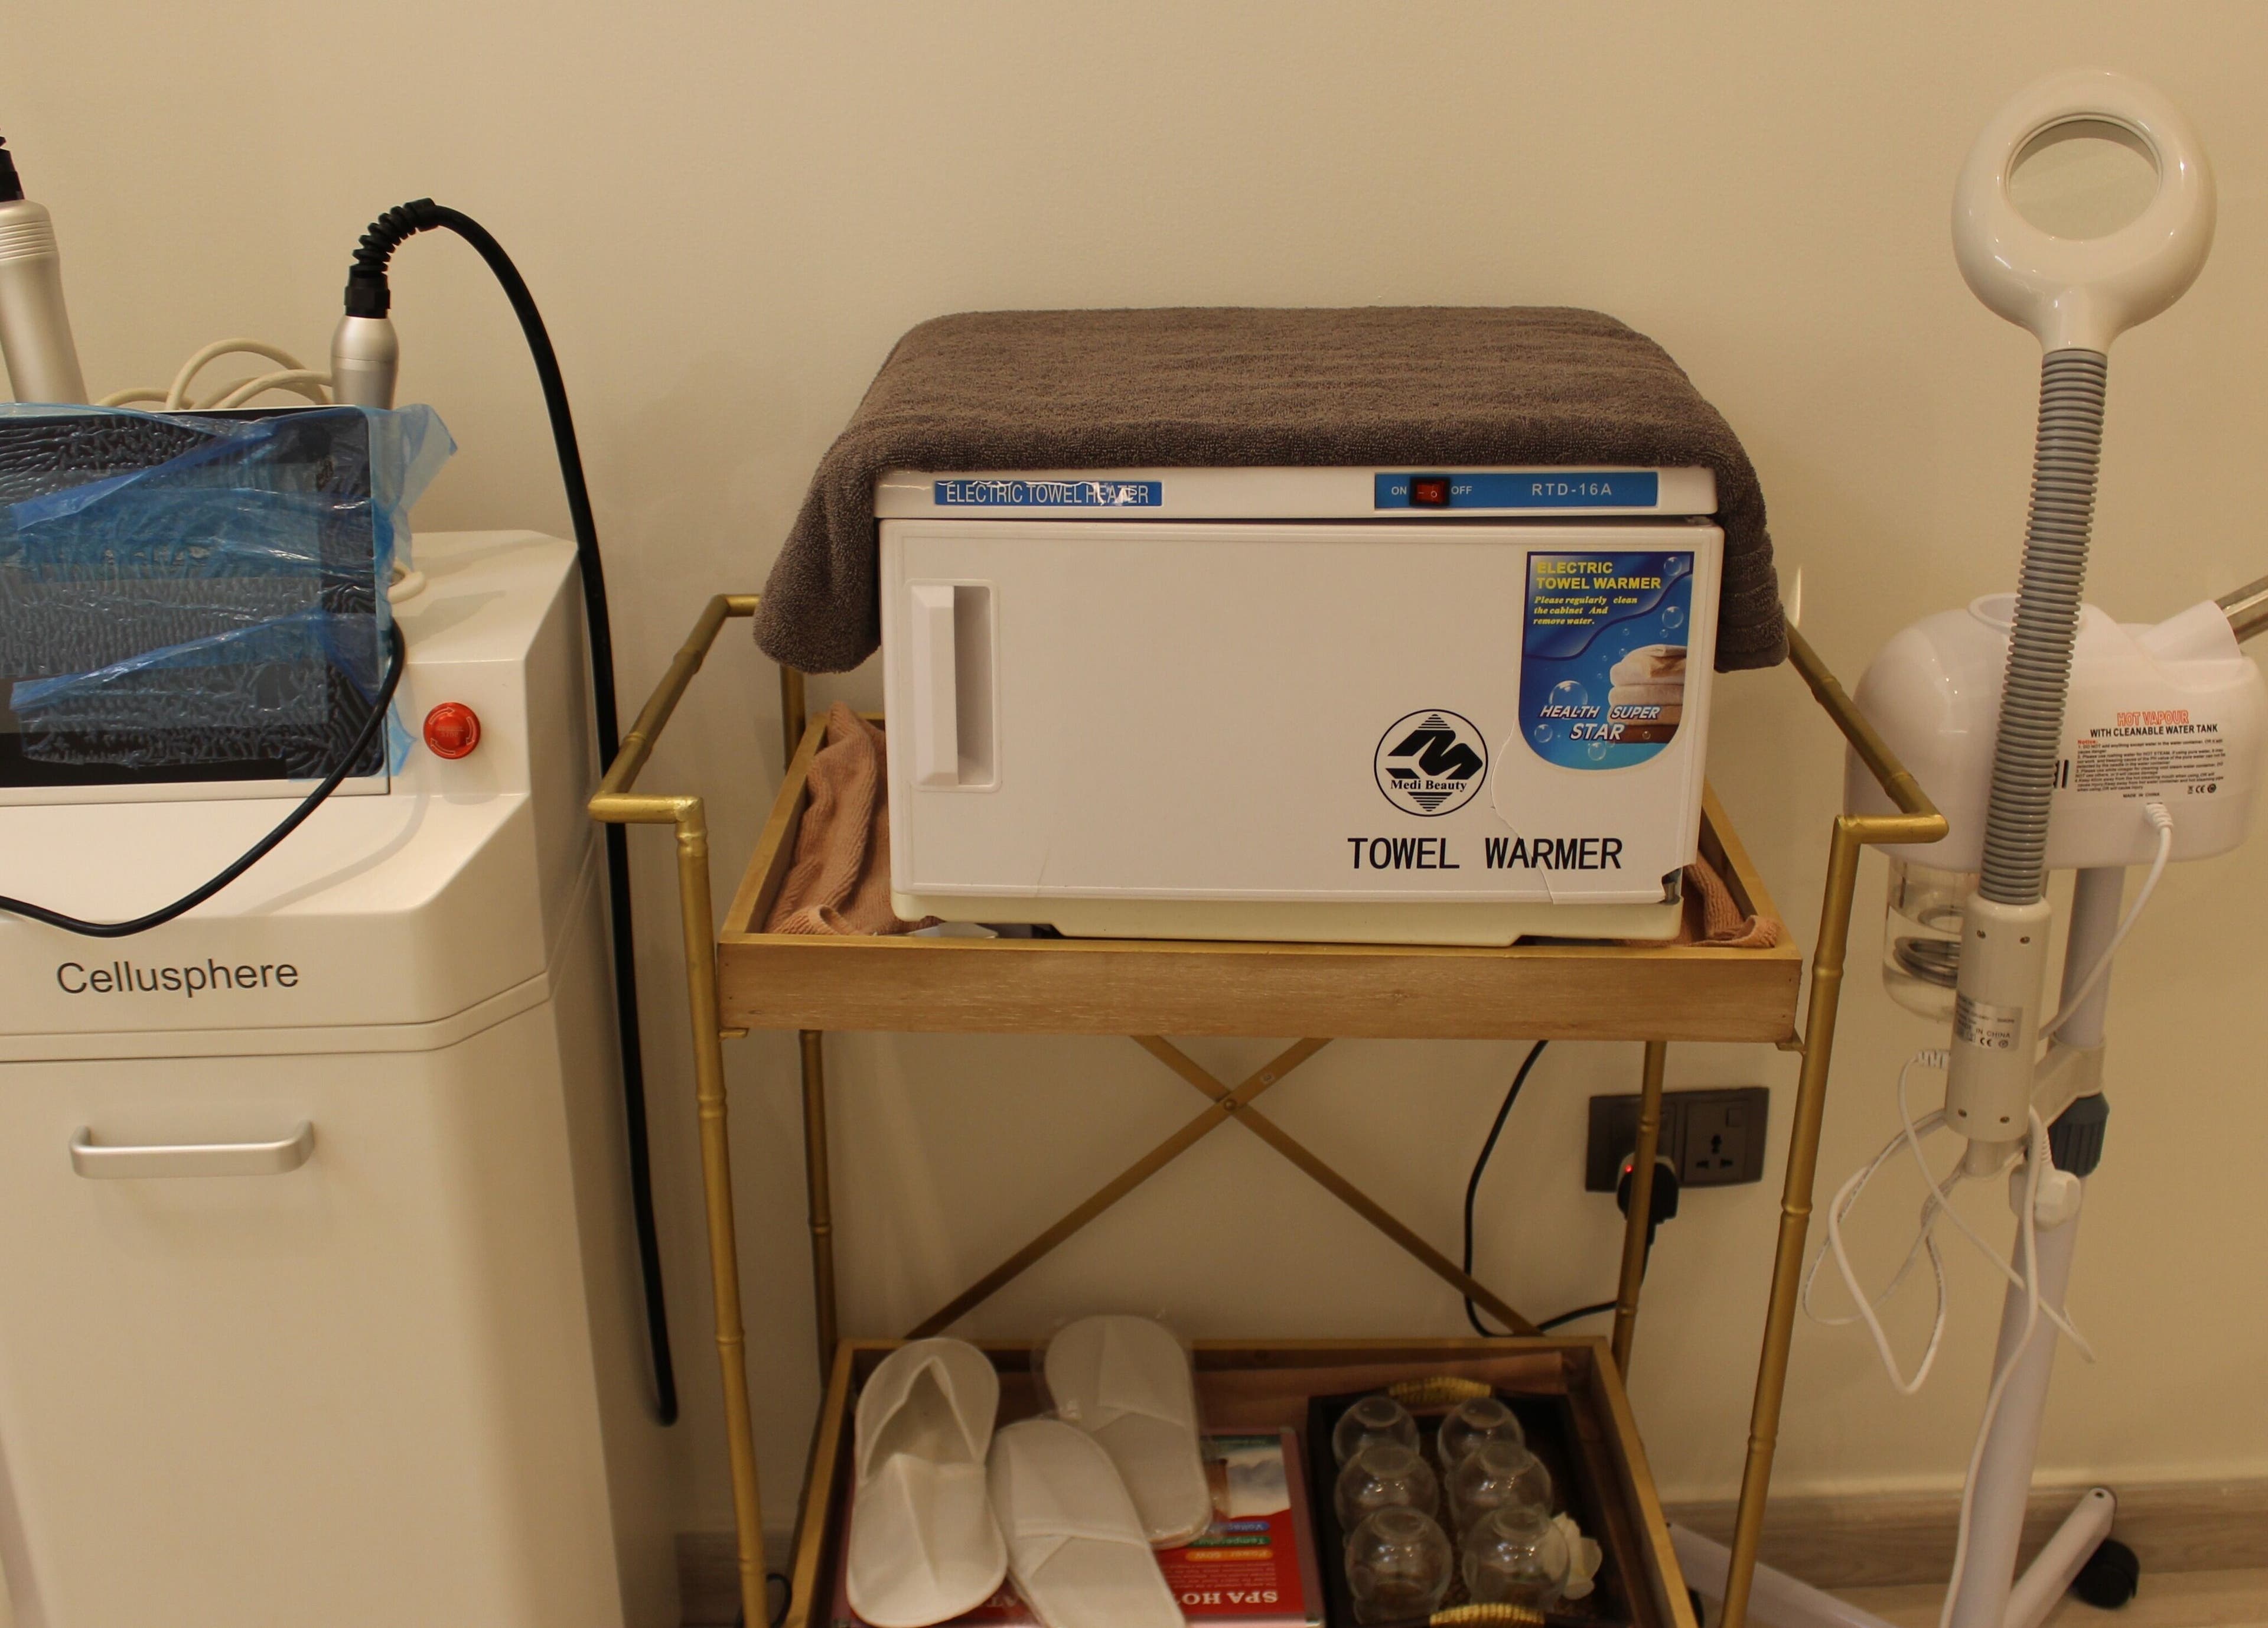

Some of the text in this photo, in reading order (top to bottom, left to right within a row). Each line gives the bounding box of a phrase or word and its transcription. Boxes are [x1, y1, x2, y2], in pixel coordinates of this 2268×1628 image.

[947, 484, 1022, 503] ELECTRIC
[1026, 484, 1082, 503] TOWEL
[1391, 486, 1407, 495] ON
[1451, 486, 1472, 495] OFF
[1531, 483, 1612, 496] RTD-16A
[1537, 562, 1613, 574] ELECTRIC
[1537, 578, 1661, 590] TOWEL WARMER
[1534, 596, 1638, 606] Please regularly clean
[1539, 706, 1661, 719] HEALTH SUPER
[2117, 710, 2189, 727] HOT VAPOUR
[1570, 723, 1625, 740] STAR
[2090, 724, 2218, 738] WITH CLEANABLE WATER TANK
[1390, 780, 1467, 793] Medi Beauty
[1347, 838, 1623, 870] TOWEL WARMER
[57, 958, 299, 998] Cellusphere
[1176, 1591, 1279, 1605] SPA HO
